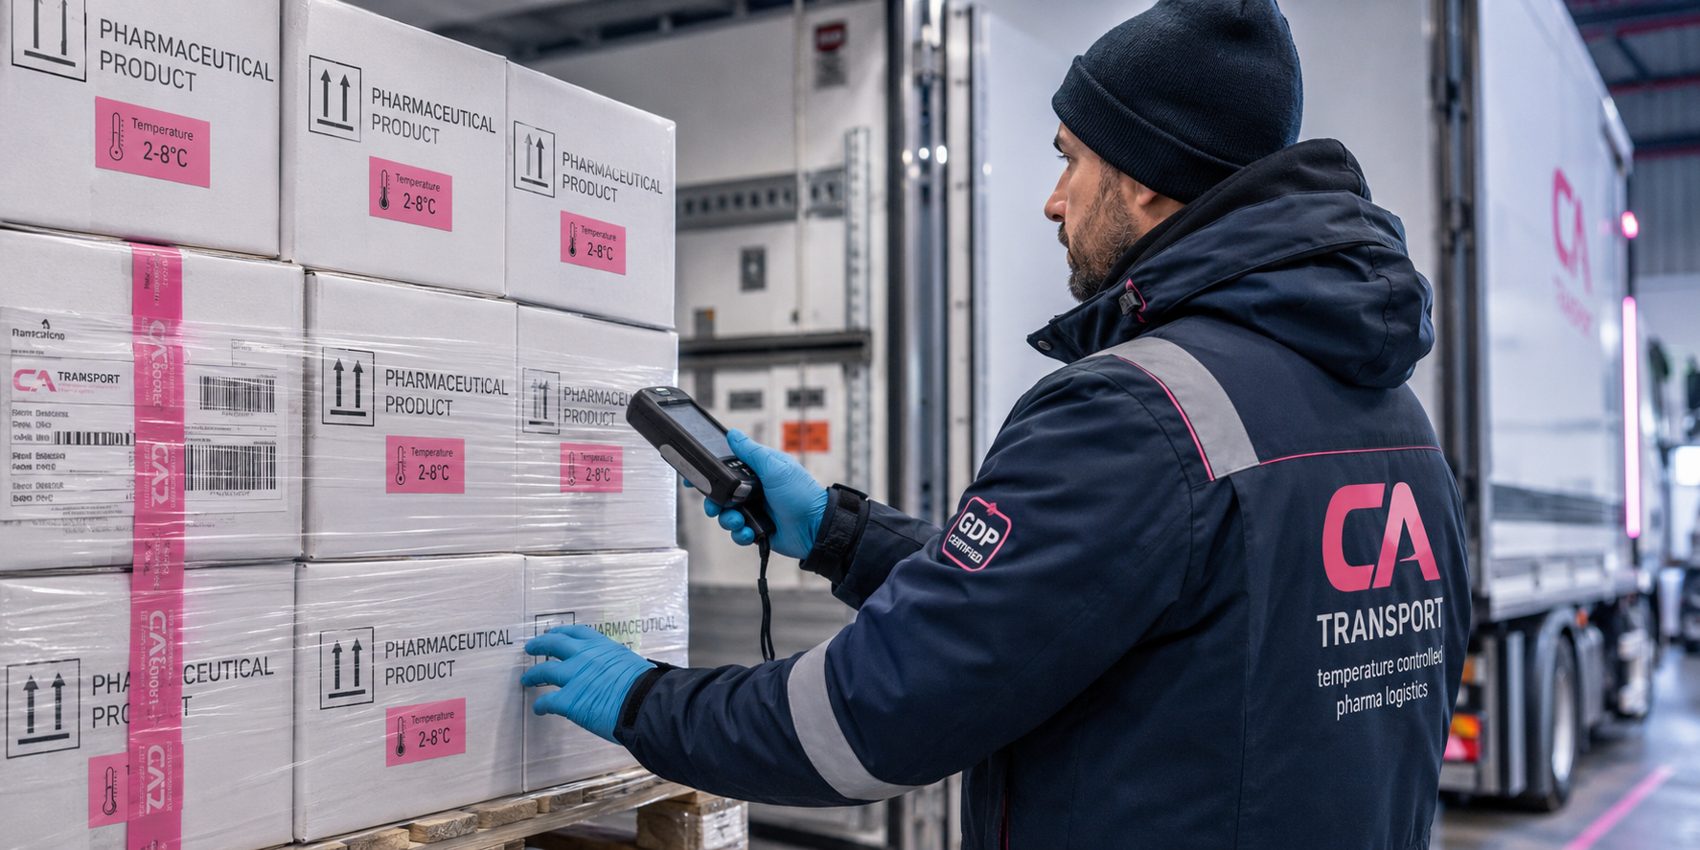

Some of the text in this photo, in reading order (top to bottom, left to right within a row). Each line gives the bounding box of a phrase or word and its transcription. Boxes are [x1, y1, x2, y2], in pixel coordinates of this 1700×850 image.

[100, 18, 274, 83] PHARMACEUTICAL
[100, 51, 197, 92] PRODUCT
[372, 87, 496, 134] PHARMACEUTICAL
[131, 117, 194, 142] Temperature
[372, 113, 440, 145] PRODUCT
[143, 141, 188, 168] 2-8°C
[395, 173, 441, 193] Temperature
[562, 151, 663, 196] PHARMACEUTICAL
[562, 175, 618, 203] PRODUCT
[403, 192, 436, 215] 2-8°C
[581, 225, 617, 241] Temperature
[587, 241, 613, 261] 2-8°C
[12, 368, 57, 392] CA
[57, 371, 120, 384] TRANSPORT
[385, 368, 509, 396] PHARMACEUTICAL
[385, 396, 453, 417] PRODUCT
[563, 386, 634, 407] PHARMACEU
[563, 408, 616, 426] PRODUCT
[411, 446, 454, 459] Temperature
[418, 463, 450, 482] 2-8°C
[586, 467, 611, 482] 2-8°C
[958, 512, 1000, 547] GDP
[1322, 481, 1441, 593] CA
[585, 616, 678, 637] ARMACEUTICAL
[1316, 597, 1444, 648] TRANSPORT
[385, 628, 514, 659] PHARMACEUTICAL
[385, 660, 455, 686] PRODUCT
[1317, 645, 1443, 689] temperature controlled
[1336, 680, 1429, 721] pharma logistics
[411, 710, 455, 726] Temperature
[418, 727, 451, 749] 2-8°C
